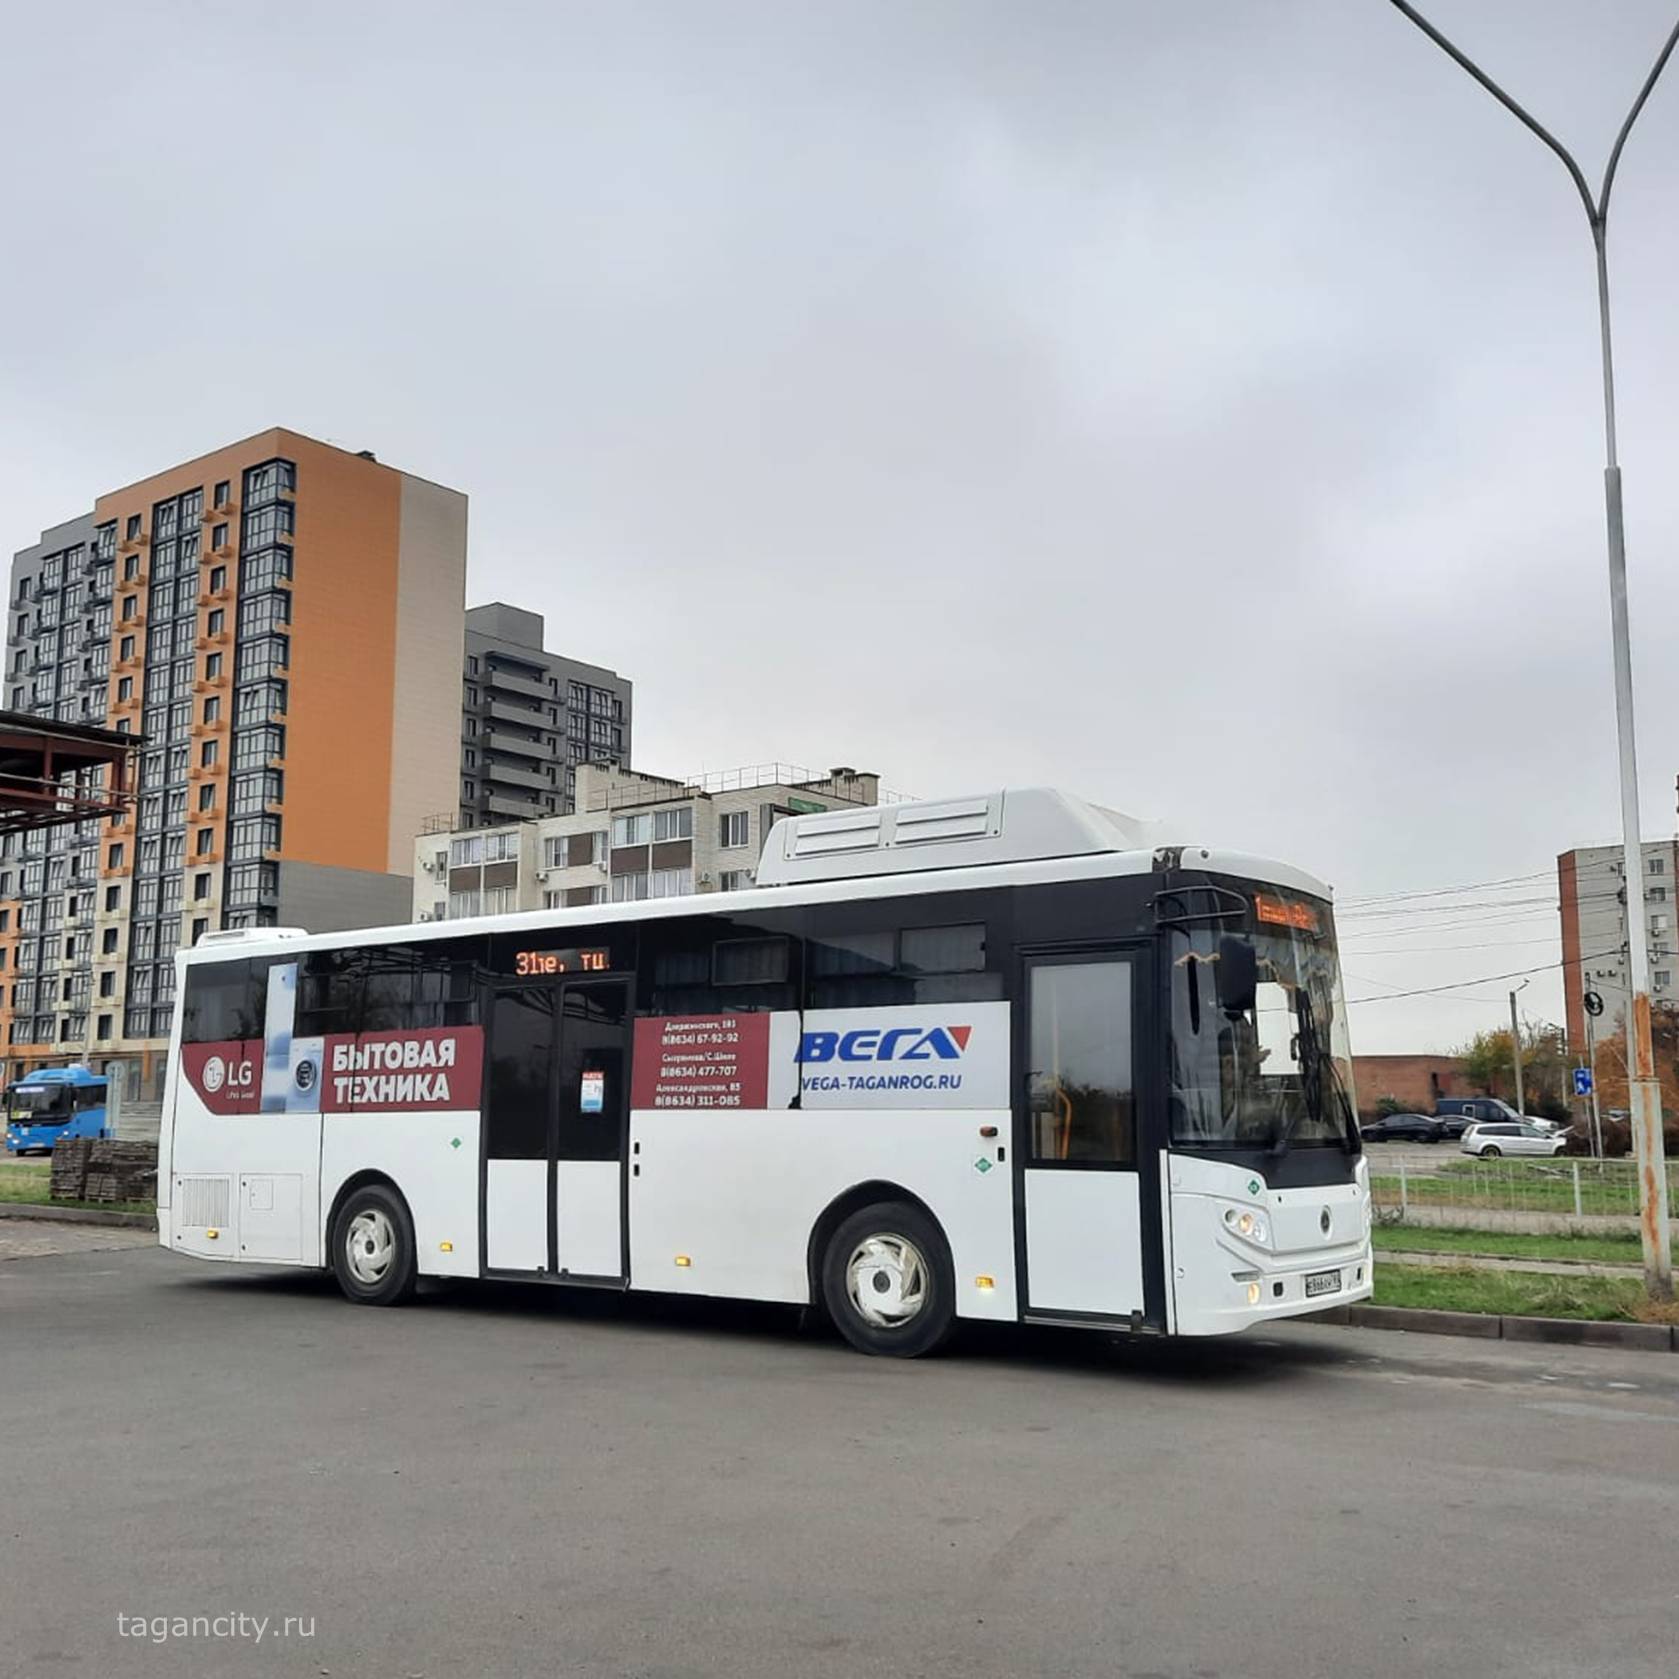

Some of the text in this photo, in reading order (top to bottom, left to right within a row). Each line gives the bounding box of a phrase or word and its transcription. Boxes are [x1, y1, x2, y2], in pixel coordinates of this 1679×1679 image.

[332, 1038, 456, 1072] БЫТОВАЯ
[227, 1060, 253, 1086] LG
[698, 1066, 738, 1076] 477-707
[332, 1072, 451, 1104] ТЕХНИКА
[800, 1075, 963, 1091] VEGA-TAGANROG.RU
[697, 1095, 741, 1105] 311-085
